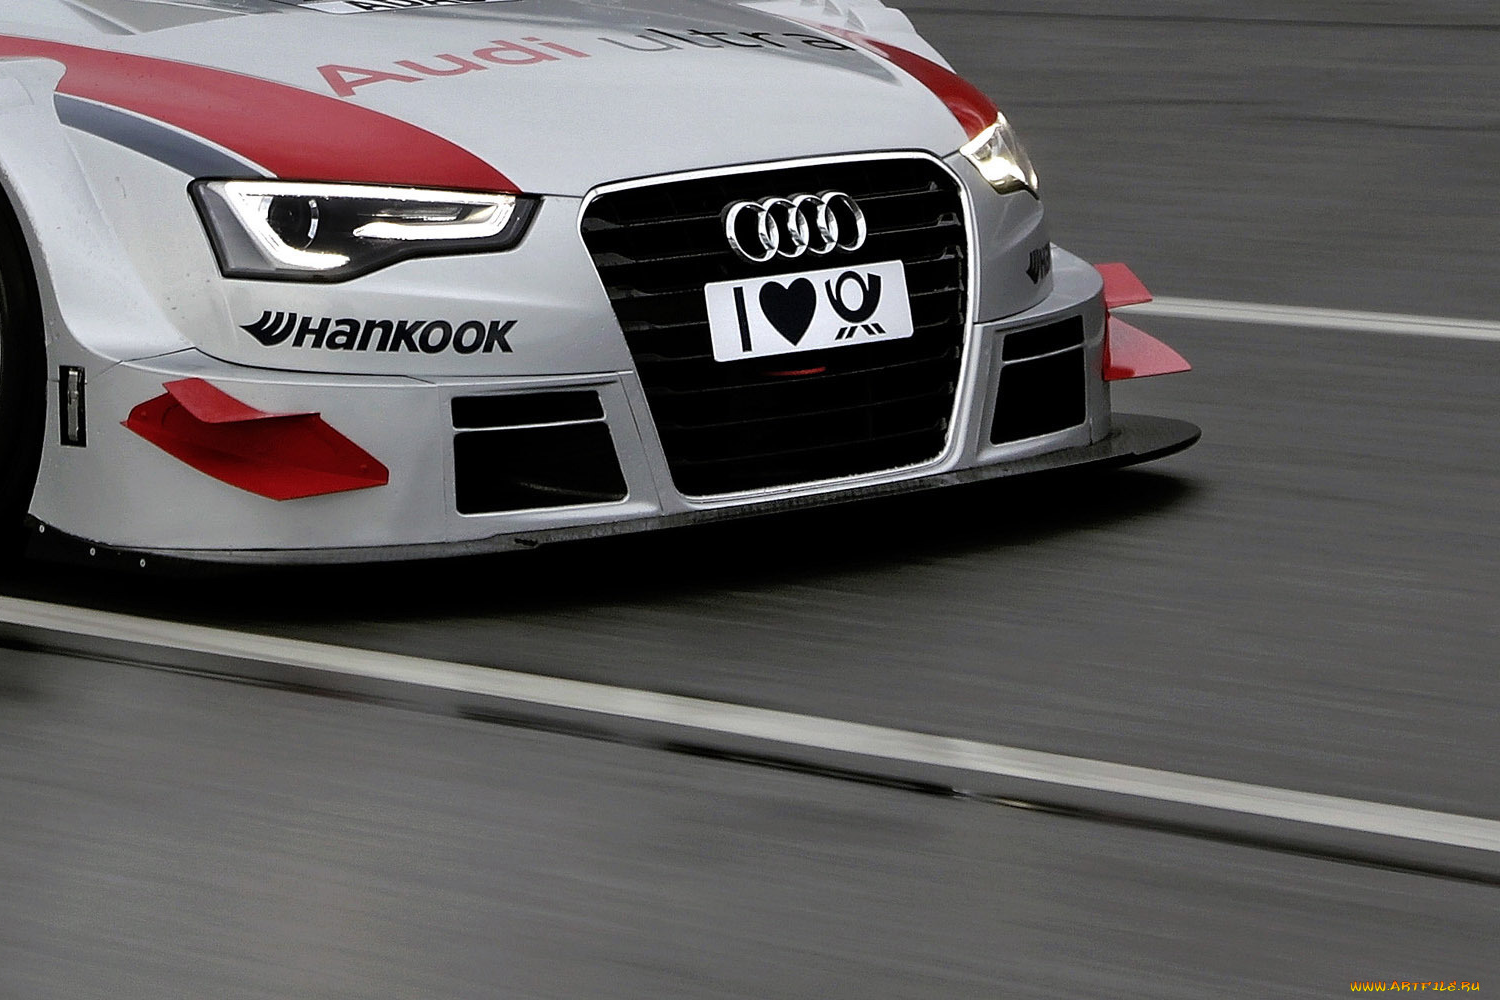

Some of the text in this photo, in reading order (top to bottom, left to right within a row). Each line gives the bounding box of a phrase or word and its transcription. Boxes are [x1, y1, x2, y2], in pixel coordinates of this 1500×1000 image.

[316, 28, 857, 97] Audi ultra
[733, 286, 753, 353] I
